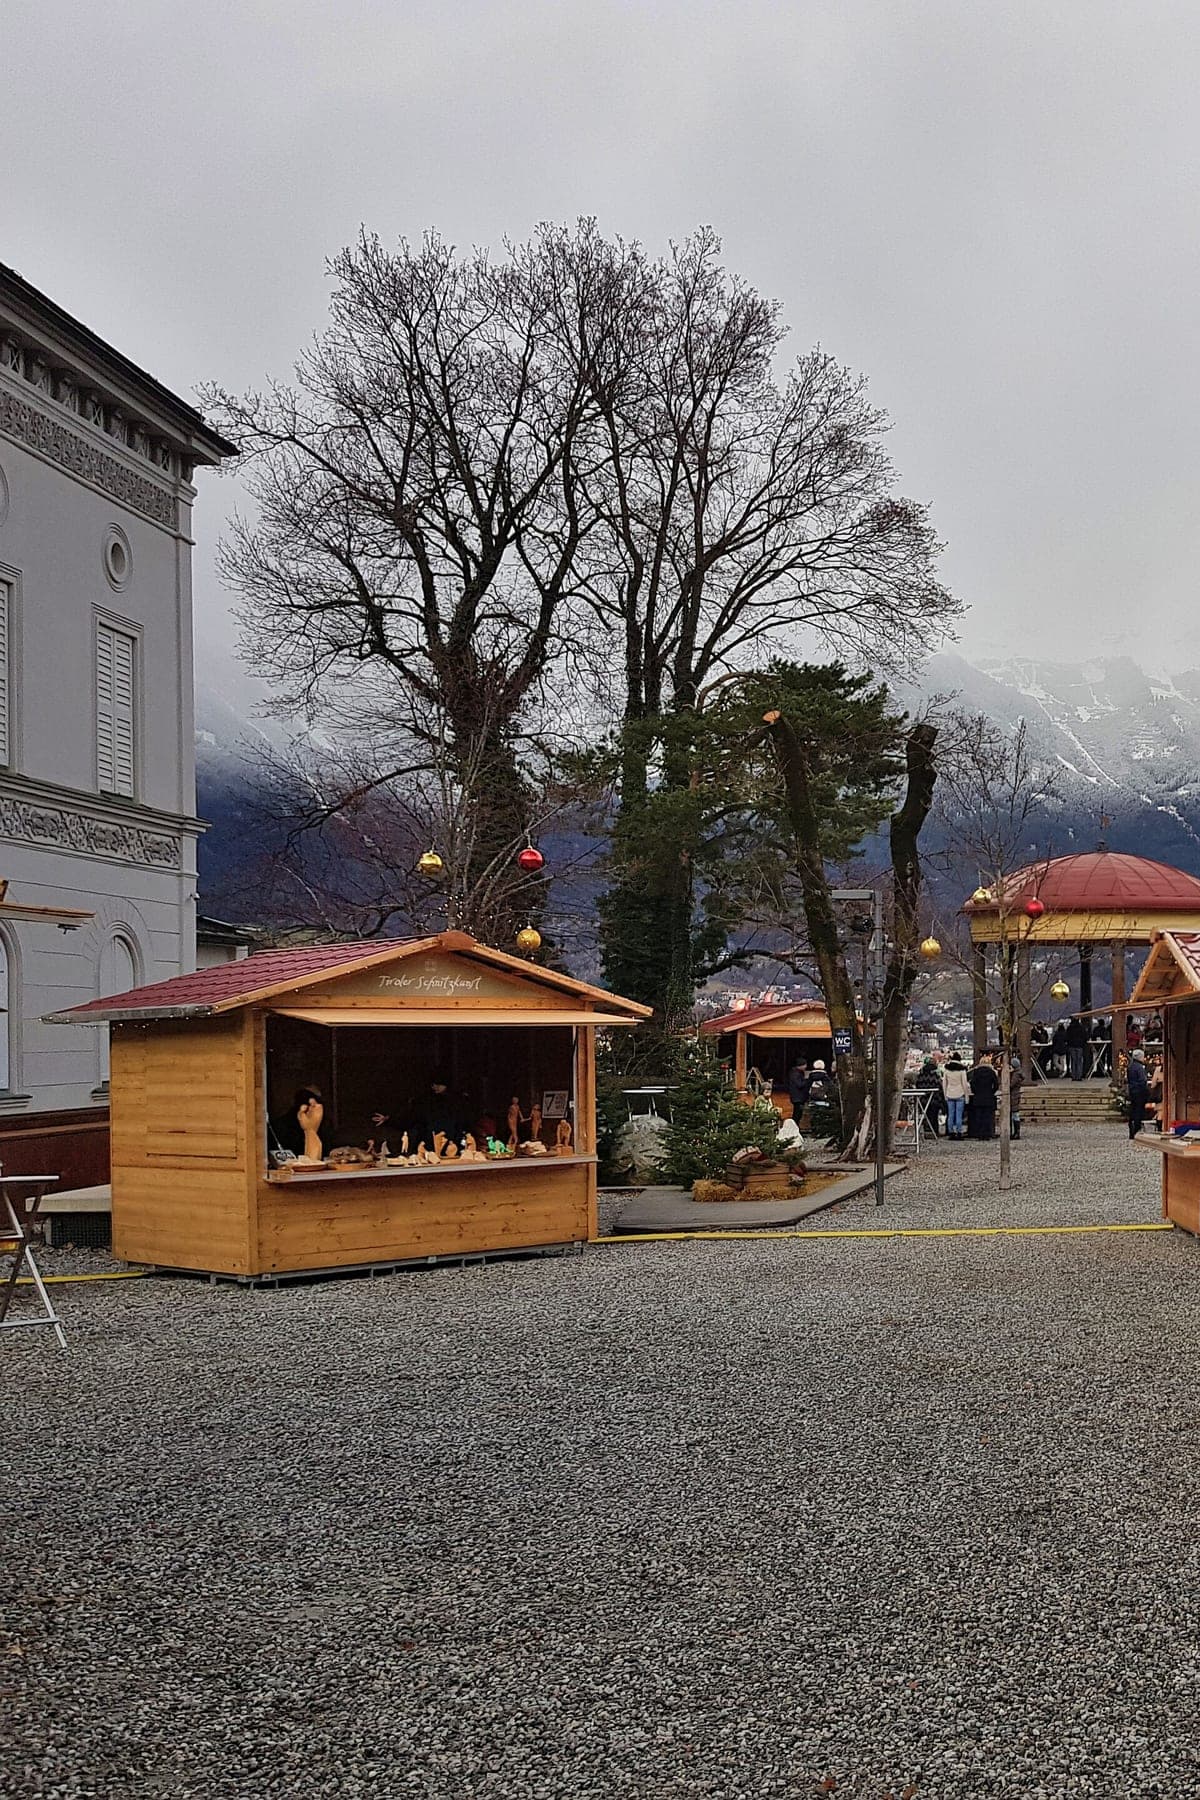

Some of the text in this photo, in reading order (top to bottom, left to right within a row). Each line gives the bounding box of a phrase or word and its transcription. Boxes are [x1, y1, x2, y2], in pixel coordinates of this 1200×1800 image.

[378, 974, 482, 996] Tiroler Schnitzkunst
[835, 1036, 851, 1045] WC
